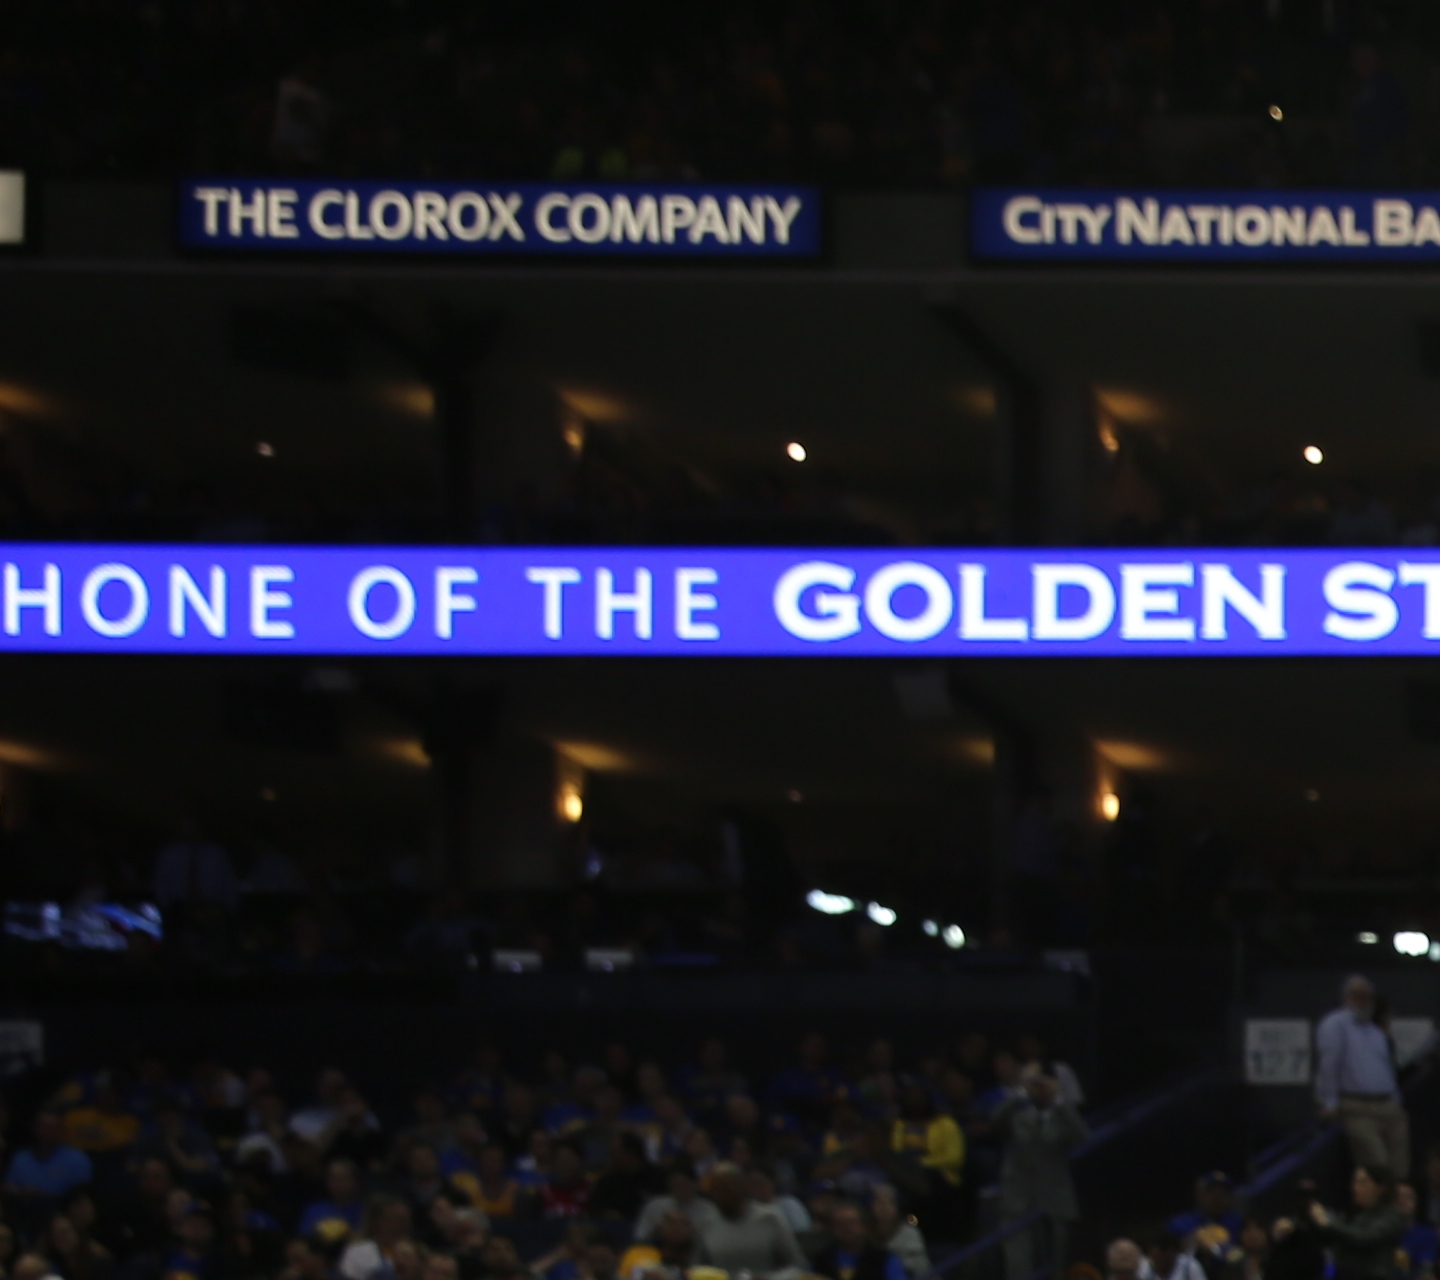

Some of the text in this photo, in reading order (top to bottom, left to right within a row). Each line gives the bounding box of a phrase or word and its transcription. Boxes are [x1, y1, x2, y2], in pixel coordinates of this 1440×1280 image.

[197, 188, 800, 244] THE CLOROX COMPANY
[348, 566, 477, 638] OF
[526, 567, 719, 639] THE
[773, 562, 1284, 640] GOLDEN
